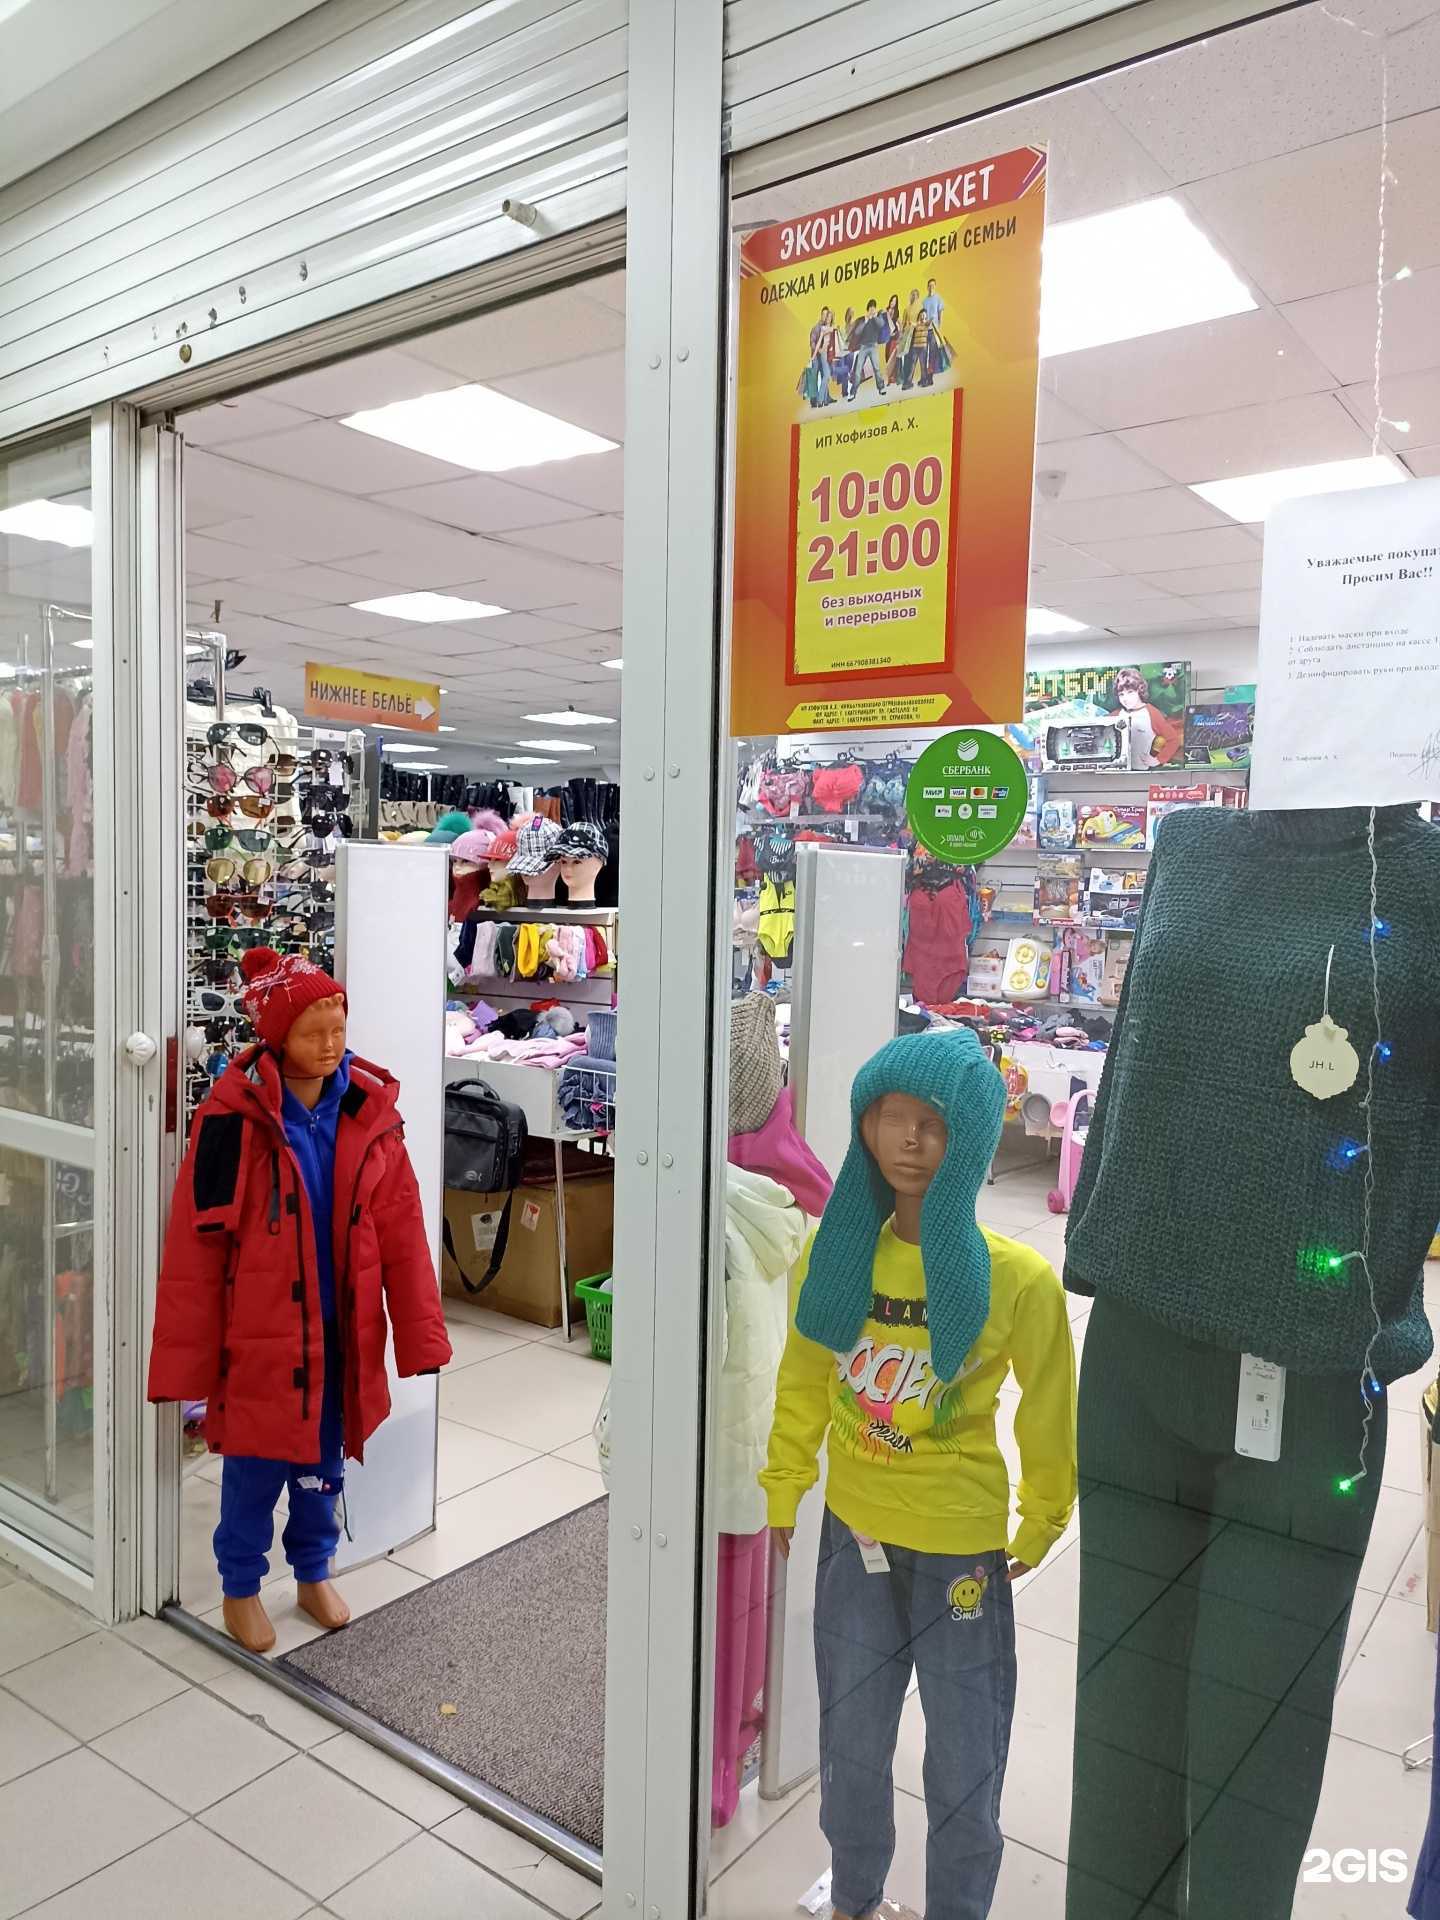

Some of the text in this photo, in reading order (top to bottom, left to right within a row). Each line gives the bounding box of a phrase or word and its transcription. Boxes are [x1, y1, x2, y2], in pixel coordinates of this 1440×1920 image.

[780, 164, 995, 260] ЭКОНОММАРКЕТ
[760, 216, 1016, 304] ОДЕЖДА И ОБУВЬ ДЛЯ ВСЕЙ СЕМЬИ
[815, 417, 919, 449] ИП Хофизов А. Х.
[811, 456, 943, 523] 10:00
[807, 518, 942, 583] 21:00
[1307, 553, 1384, 568] Уважаемые
[1342, 566, 1433, 586] Просим Вас!!
[821, 587, 922, 610] без выходных
[825, 606, 917, 627] и перерывов
[1366, 630, 1381, 639] при
[1396, 665, 1412, 675] при
[310, 680, 413, 713] НИЖНЕЕ БЕЛЬЁ
[942, 765, 991, 775] СБЕРБАНК
[925, 788, 943, 796] МИР
[951, 1603, 984, 1621] Smile
